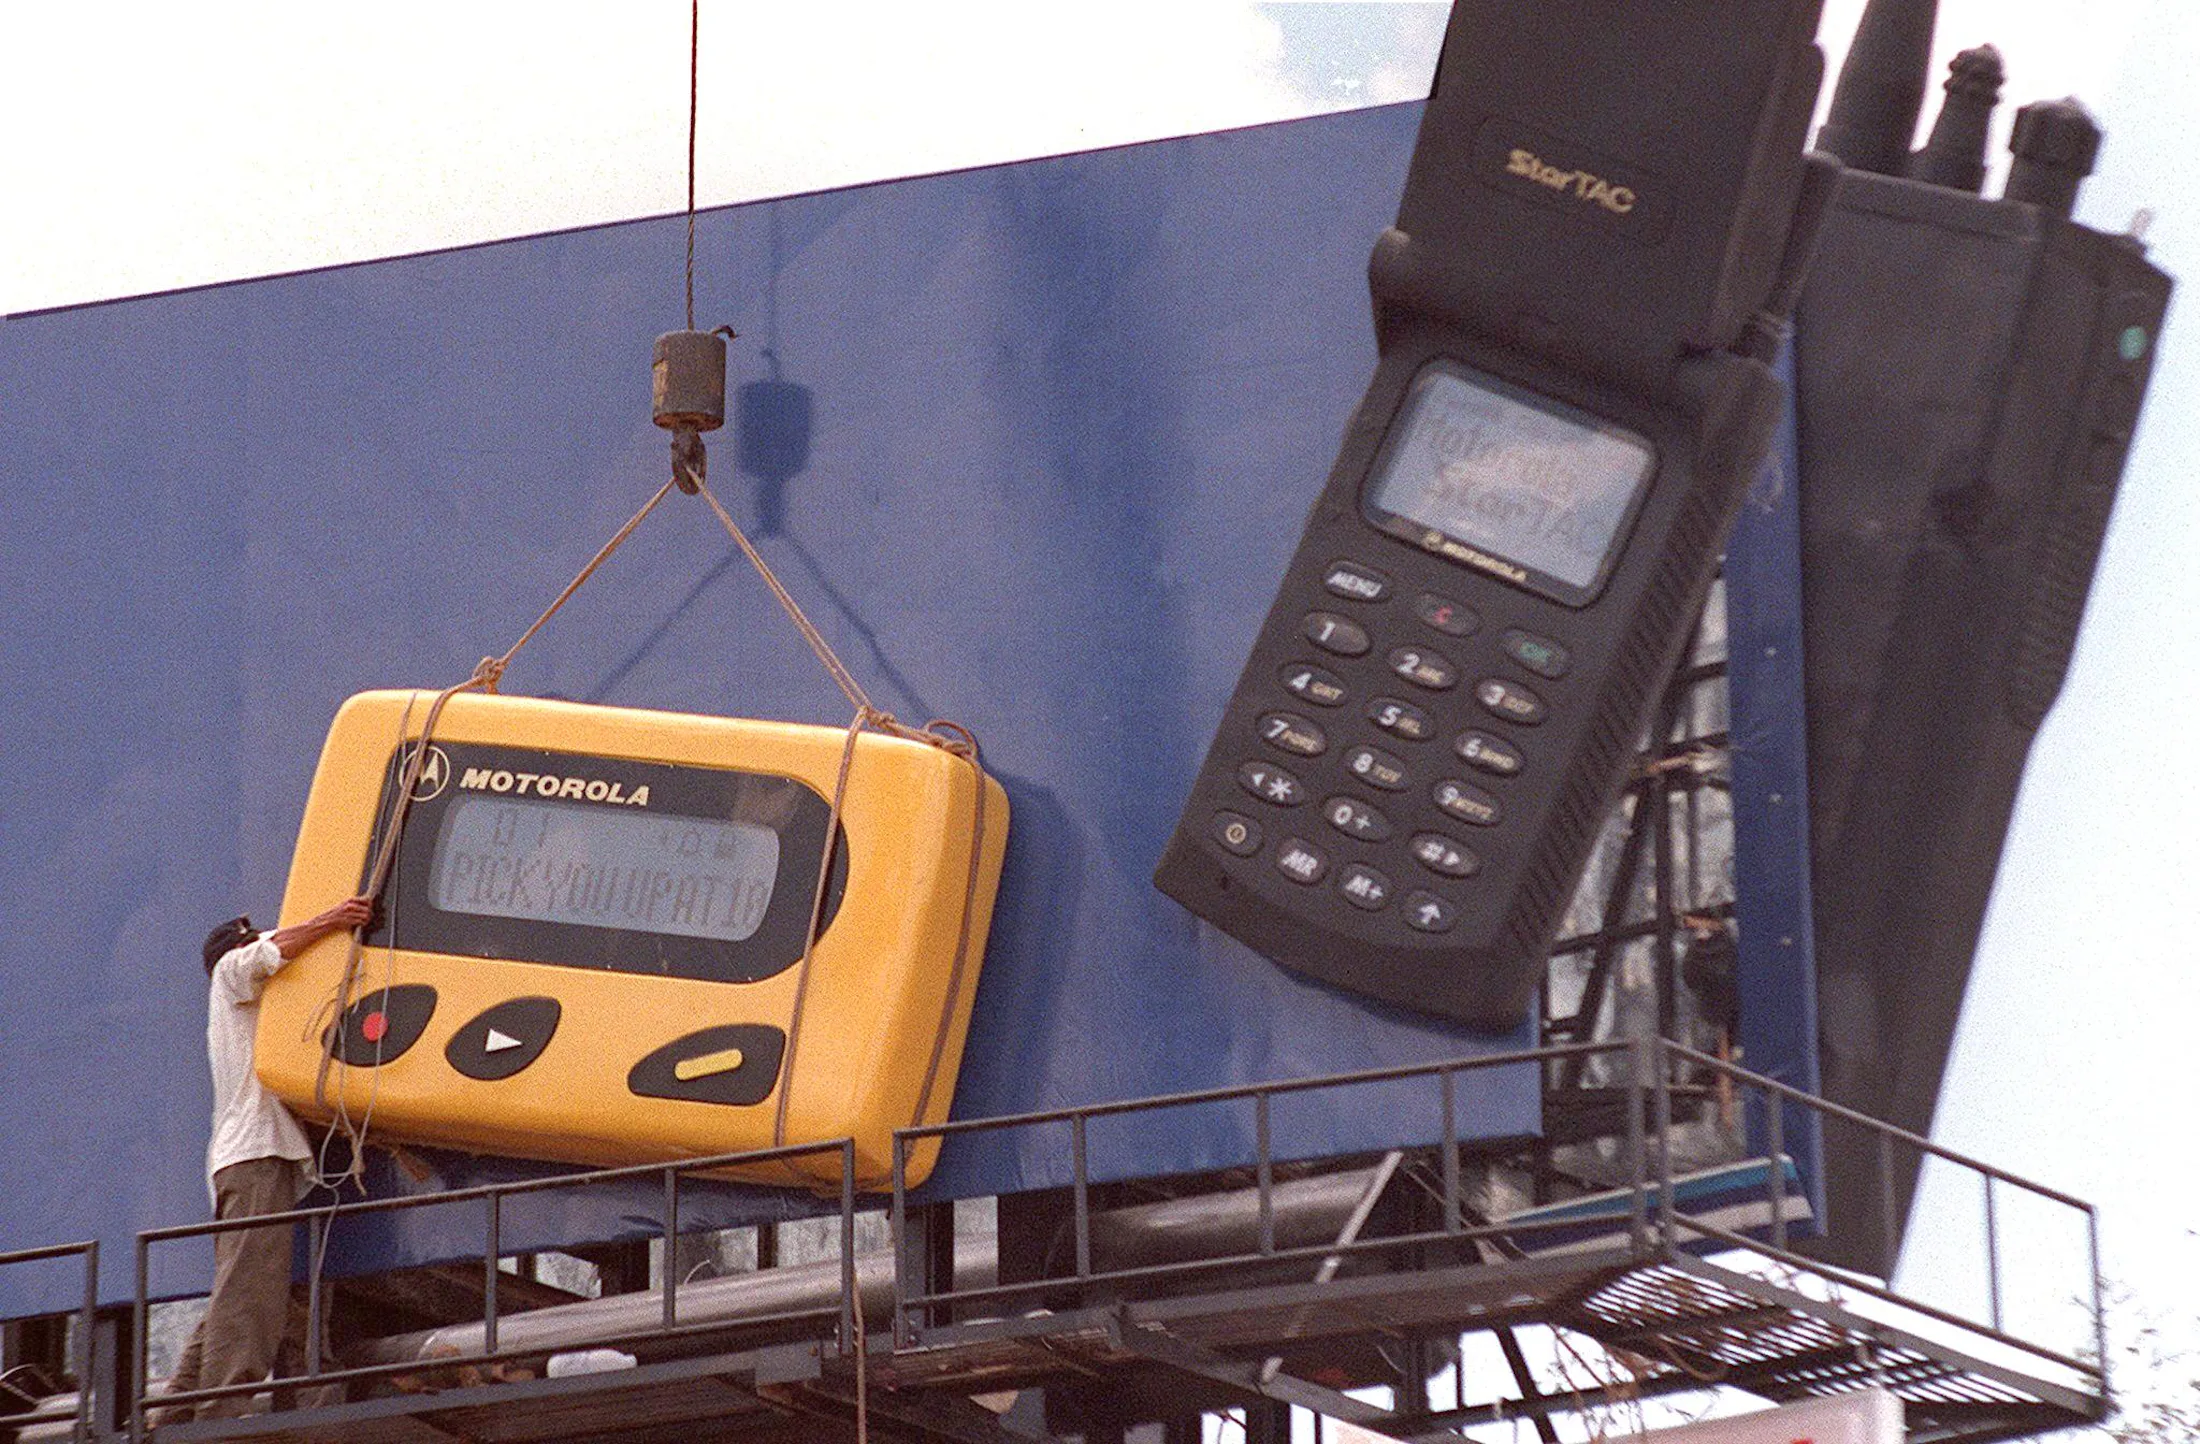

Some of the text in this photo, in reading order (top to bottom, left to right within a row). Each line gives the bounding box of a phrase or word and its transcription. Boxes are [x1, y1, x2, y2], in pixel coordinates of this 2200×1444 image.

[1505, 149, 1637, 213] StarTAC
[1325, 570, 1383, 598] MENU
[1319, 622, 1336, 641] 1
[1396, 652, 1420, 674] 2
[1290, 672, 1312, 690] 4
[1484, 683, 1506, 706] 3
[1378, 705, 1402, 727] 5
[1267, 718, 1290, 739] 7
[1463, 738, 1482, 758] 6
[1352, 752, 1374, 773] 8
[459, 767, 651, 806] MOTOROLA
[1442, 785, 1459, 806] 9
